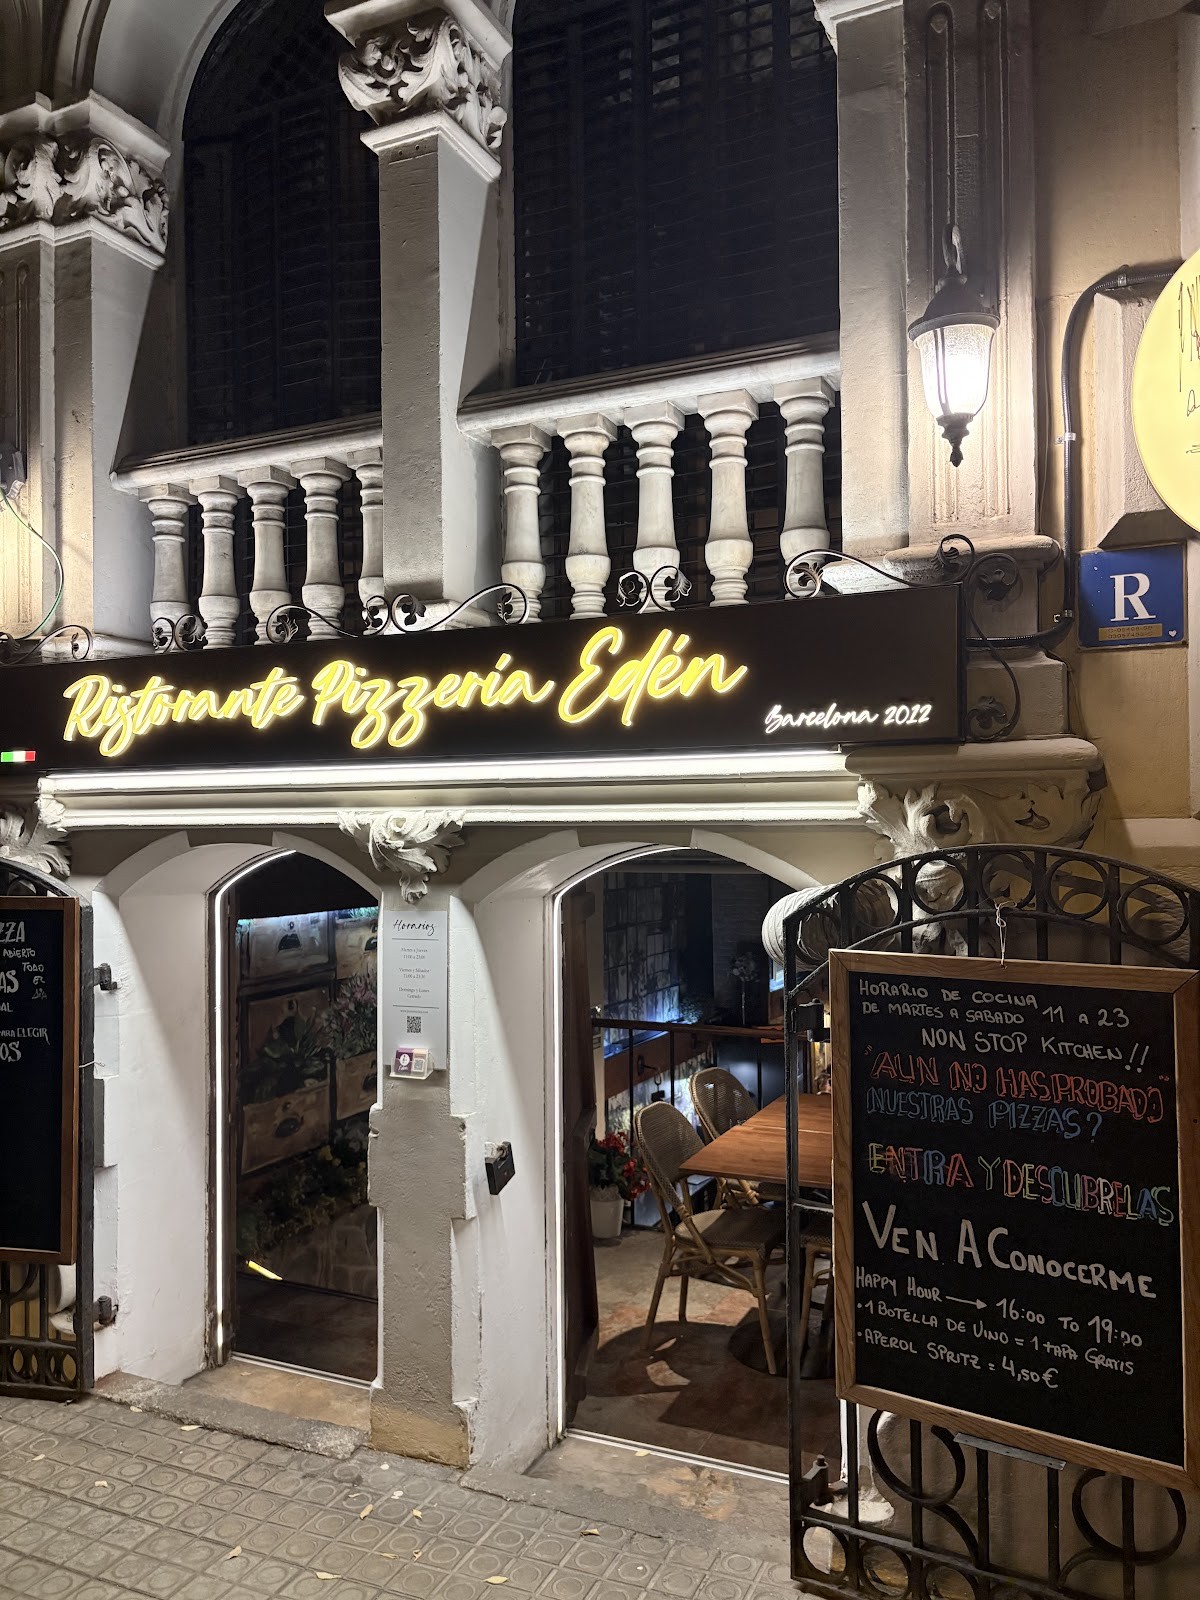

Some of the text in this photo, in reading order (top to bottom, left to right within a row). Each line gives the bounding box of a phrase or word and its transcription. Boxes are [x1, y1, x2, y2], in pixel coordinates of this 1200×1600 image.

[1110, 571, 1157, 622] R
[63, 626, 749, 758] Ristorante Pizzería Edén
[764, 702, 933, 735] Barcelona 2012
[859, 978, 1039, 1010] HORARIO DE COCINA
[862, 1001, 880, 1015] DE
[887, 1002, 944, 1019] MARTES
[949, 1007, 960, 1019] A
[965, 1009, 1025, 1025] SABADO
[1042, 1005, 1065, 1024] 11
[1097, 1007, 1131, 1029] 23
[921, 1027, 967, 1052] NON
[974, 1030, 1028, 1054] STOP
[948, 1060, 988, 1094] NO
[995, 1066, 1051, 1101] HAS
[866, 1085, 975, 1125] NUESTRAS
[867, 1142, 1175, 1227] ENTRA Y DESCUBRELAS
[861, 1200, 940, 1262] VEN
[957, 1218, 983, 1269] A
[995, 1297, 1046, 1325] 16:00
[1057, 1316, 1081, 1333] TO
[864, 1327, 918, 1355] APEROL
[926, 1341, 982, 1371] SPRITZ
[877, 1300, 939, 1329] BOTELLA
[945, 1317, 967, 1334] DE
[972, 1319, 1010, 1345] VINO
[1029, 1334, 1039, 1351] 1
[1084, 1347, 1135, 1376] GRATIS
